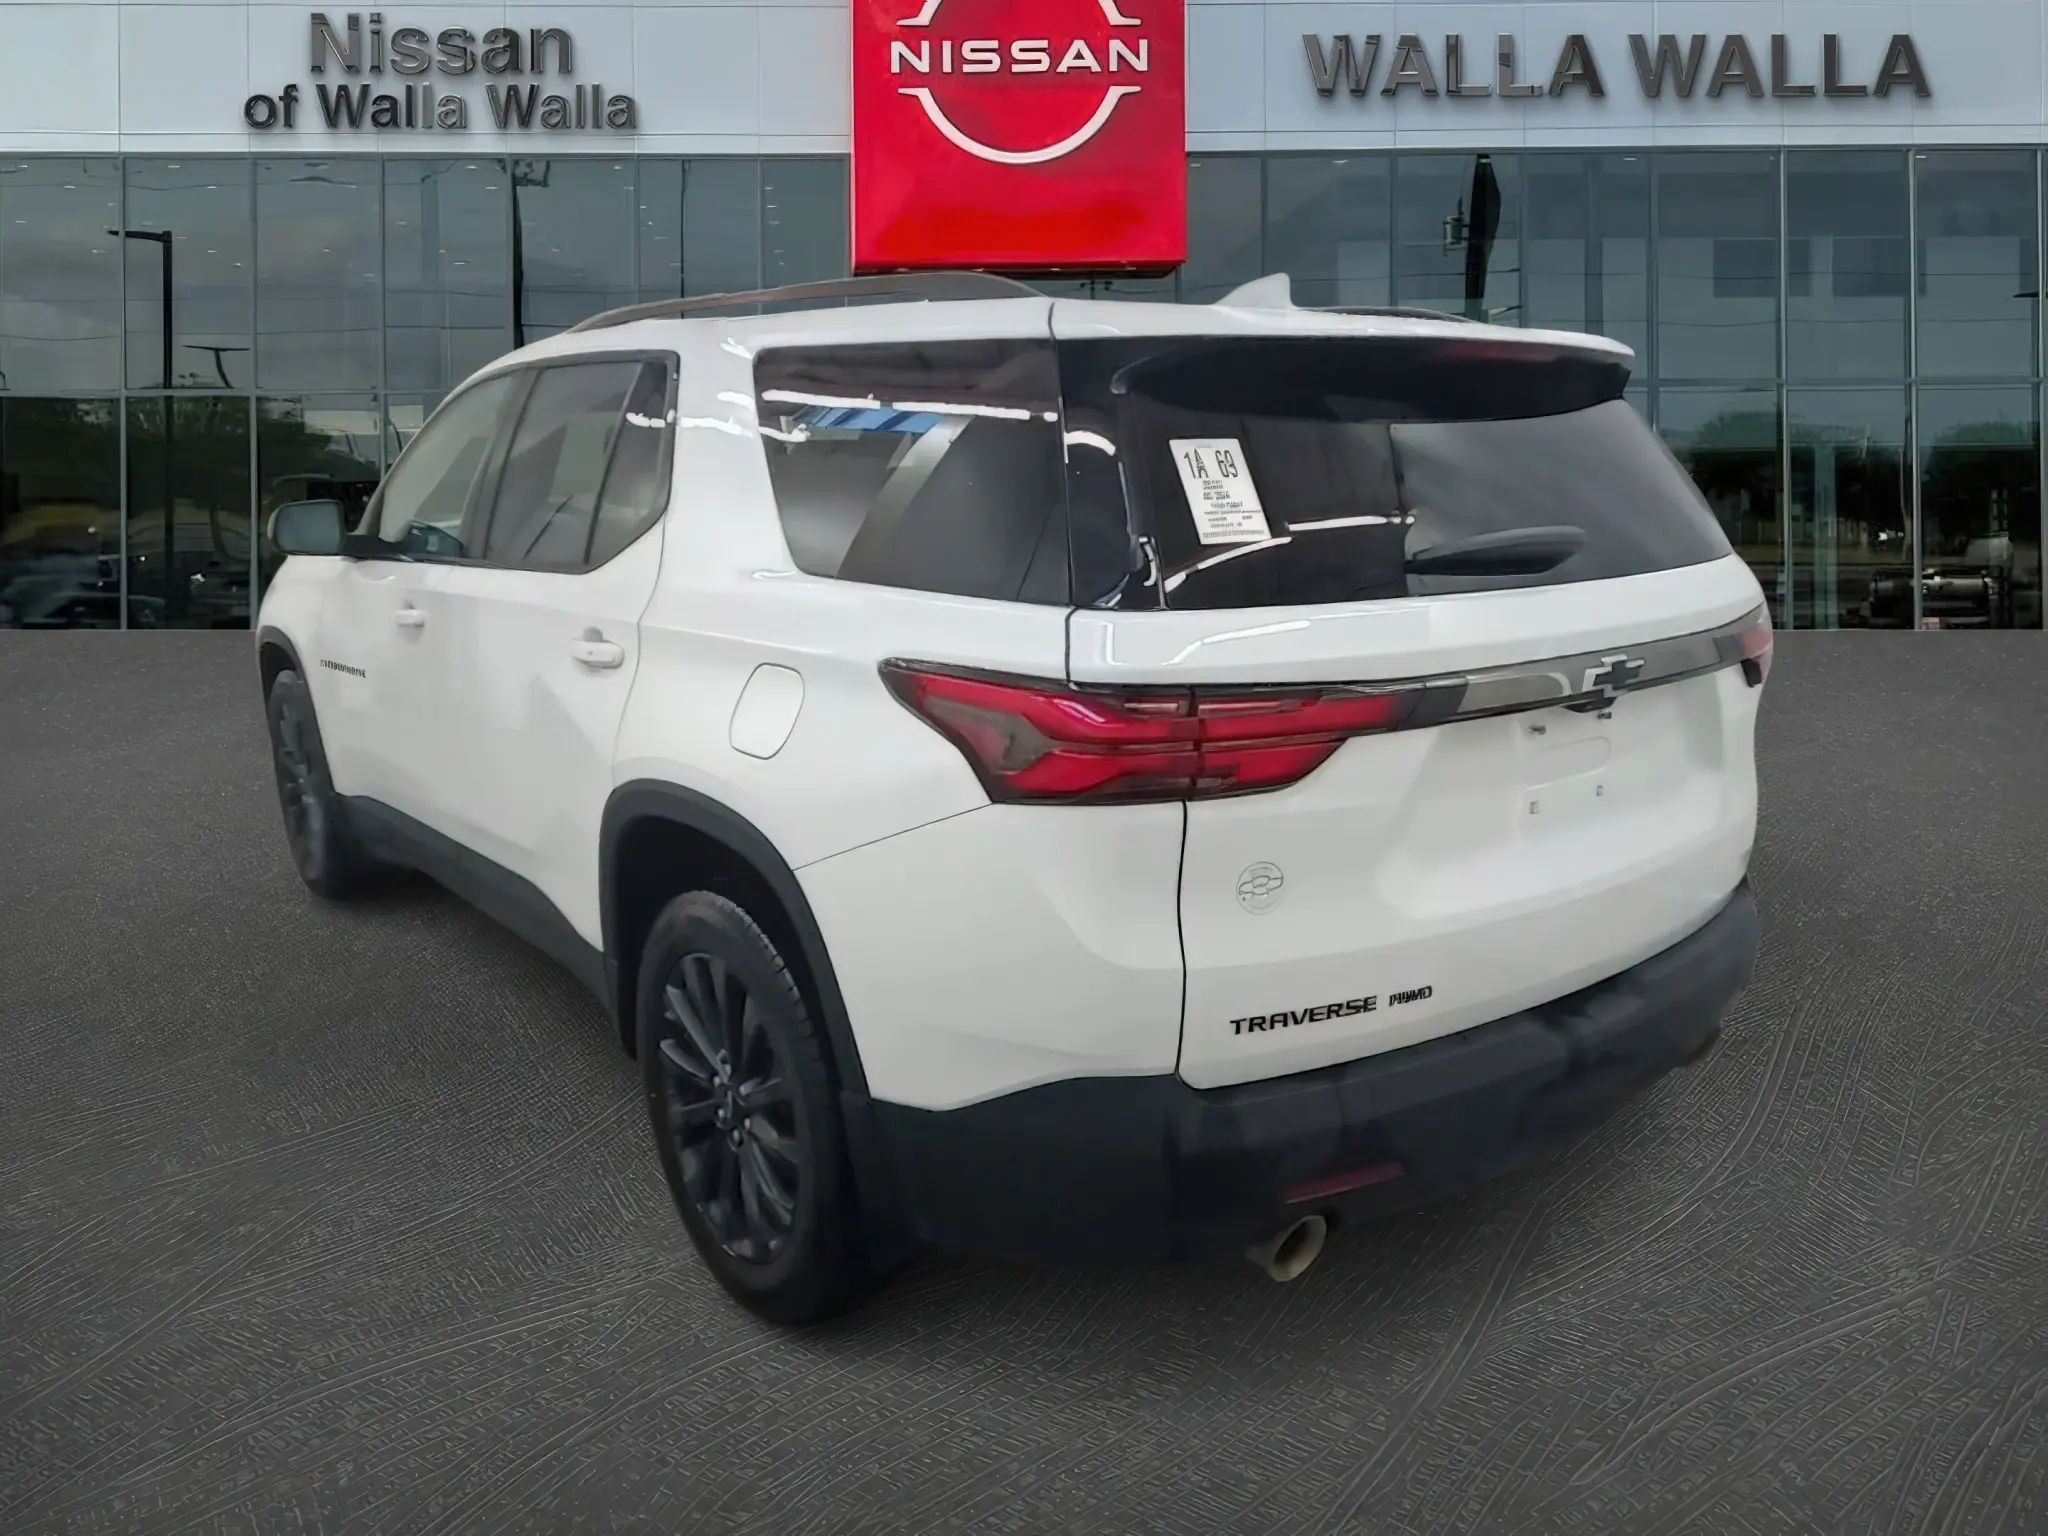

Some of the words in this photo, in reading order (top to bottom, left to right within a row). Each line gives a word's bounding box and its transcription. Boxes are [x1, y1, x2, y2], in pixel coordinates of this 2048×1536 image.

[310, 12, 572, 76] Nissan
[890, 38, 1148, 74] NISSAN
[1302, 33, 1605, 97] WALLA
[1627, 33, 1932, 97] WALLA
[243, 83, 299, 129] of
[316, 82, 468, 129] Walla
[485, 83, 637, 129] Walla
[1229, 995, 1378, 1035] TRAVERSE
